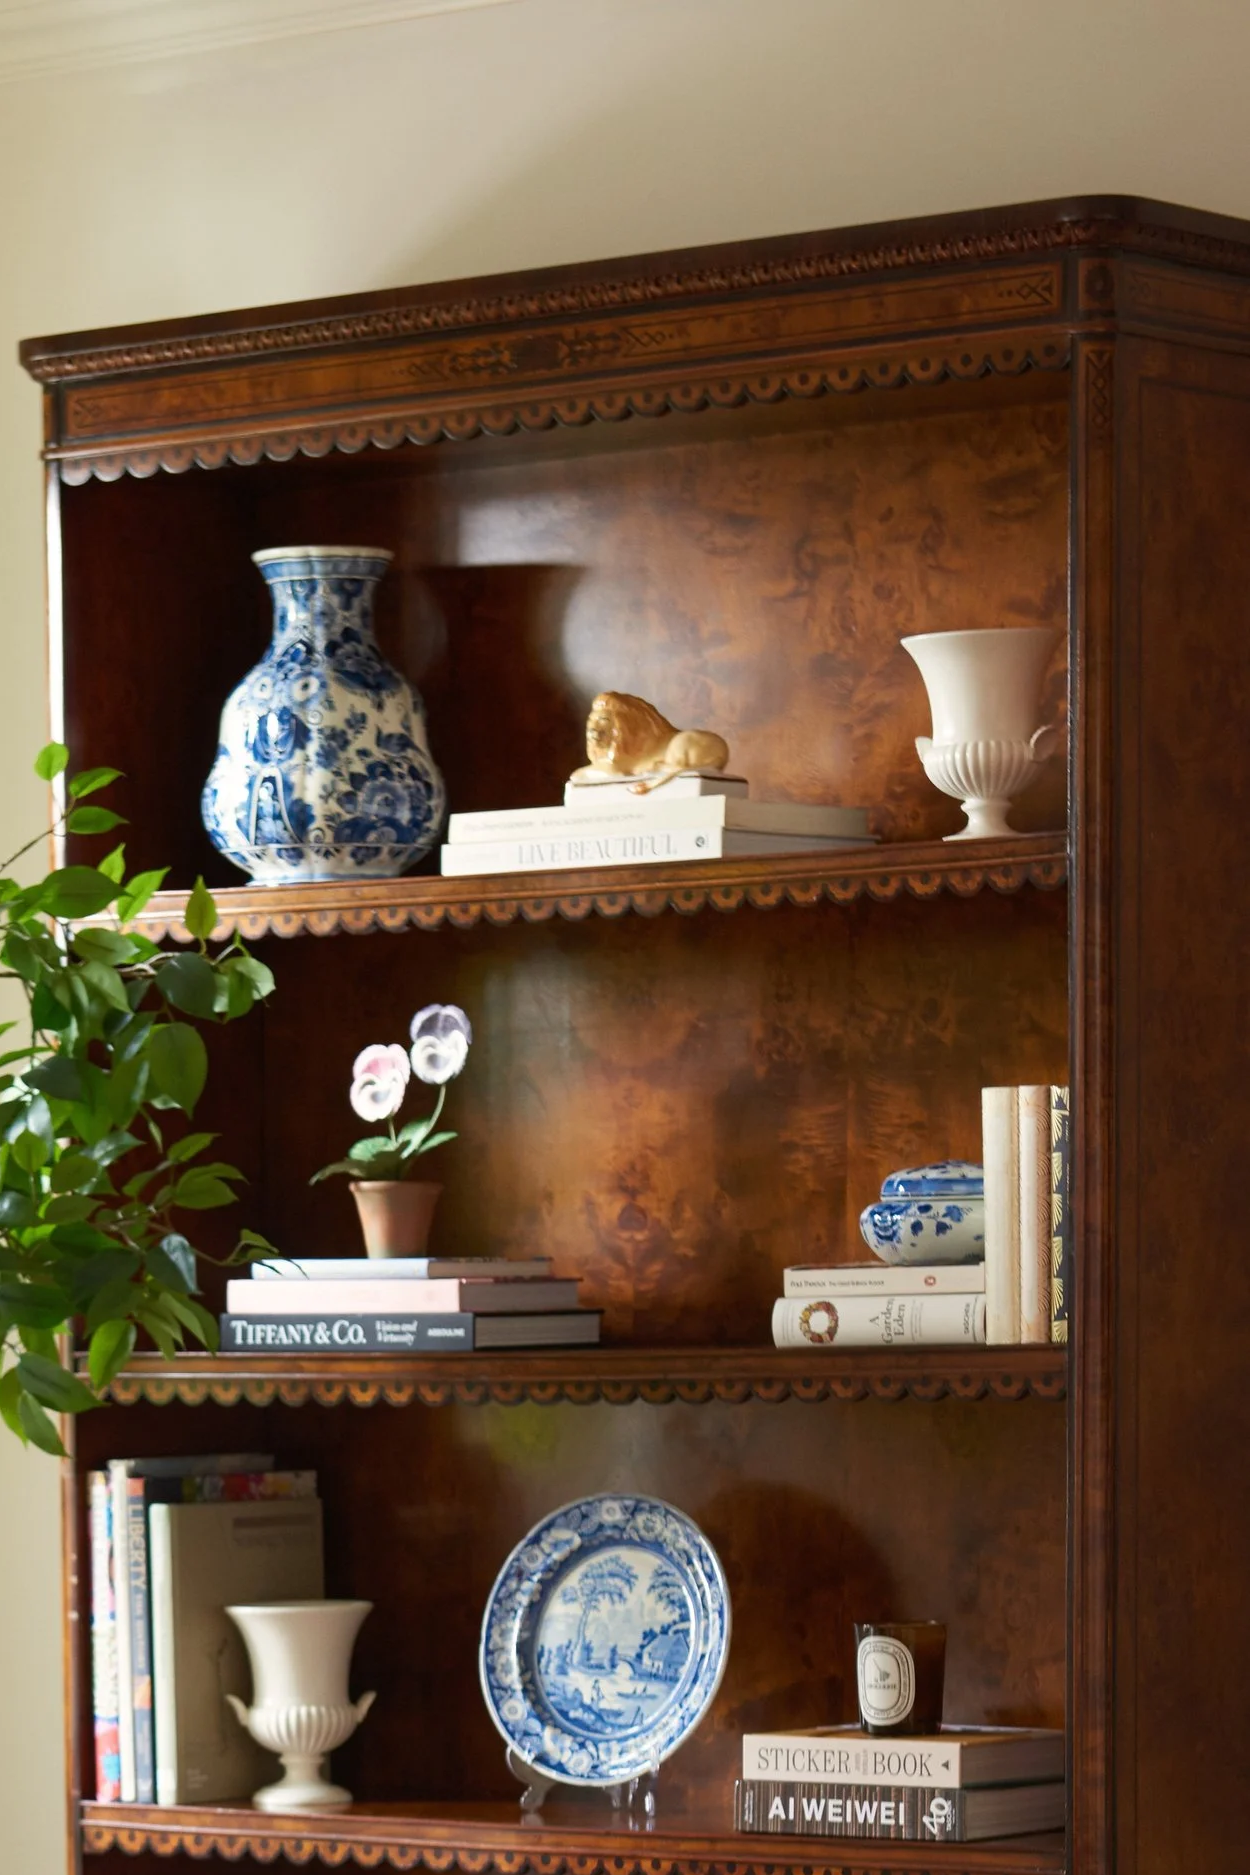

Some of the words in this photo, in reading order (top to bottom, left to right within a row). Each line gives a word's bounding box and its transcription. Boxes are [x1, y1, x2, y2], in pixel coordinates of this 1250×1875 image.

[517, 841, 560, 865] LIVE
[567, 833, 678, 861] BEAUTIFUL
[869, 1315, 879, 1327] A
[881, 1298, 895, 1344] Garden
[893, 1304, 906, 1336] Eden
[757, 1747, 851, 1774] STICKER
[873, 1751, 933, 1777] BOOK
[768, 1796, 795, 1821] AI
